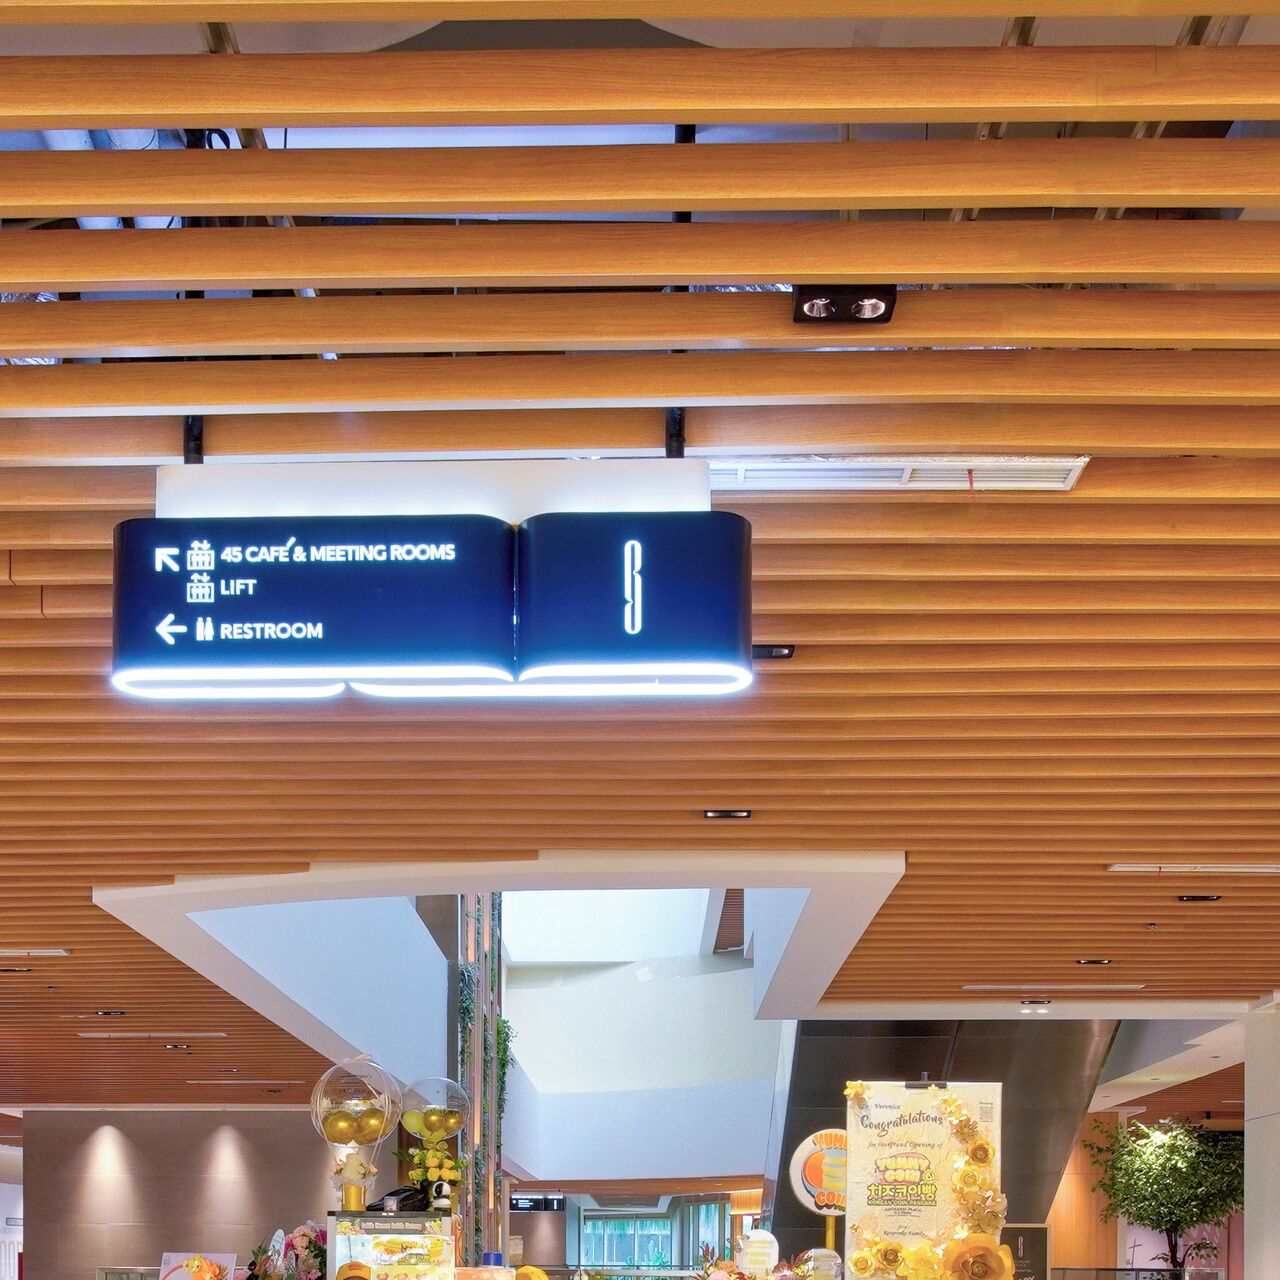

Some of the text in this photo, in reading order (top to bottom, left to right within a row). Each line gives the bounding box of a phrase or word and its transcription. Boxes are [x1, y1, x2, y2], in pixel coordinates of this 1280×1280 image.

[221, 546, 242, 562] 45
[293, 546, 306, 561] &
[310, 545, 387, 561] MEETING
[391, 544, 455, 560] ROOMS
[221, 579, 257, 595] LIFT
[221, 623, 323, 639] RESTROOM
[861, 1110, 943, 1137] Congratulations
